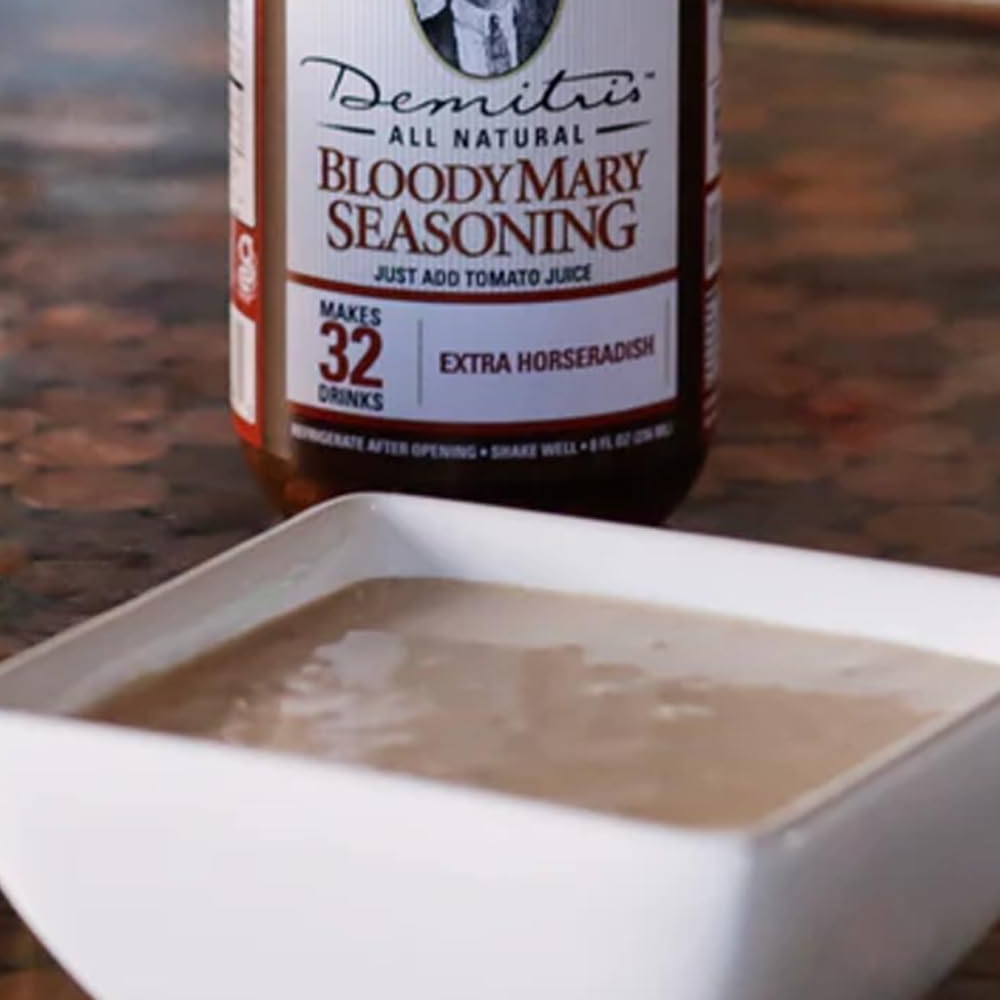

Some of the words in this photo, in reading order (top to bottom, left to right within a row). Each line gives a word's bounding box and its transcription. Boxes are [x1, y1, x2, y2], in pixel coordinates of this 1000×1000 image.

[388, 125, 437, 148] ALL
[453, 124, 585, 149] NATURAL
[317, 145, 513, 204] BLOODY
[515, 149, 649, 204] MARY
[326, 198, 638, 258] SEASONING
[373, 264, 418, 286] JUST
[421, 268, 461, 288] ADD
[465, 267, 541, 288] TOMATO
[544, 263, 593, 285] JUICE
[320, 300, 382, 326] MAKES
[318, 320, 384, 389] 32
[439, 352, 513, 374] EXTRA
[517, 334, 656, 373] HORSERADISH
[317, 383, 385, 412] DRINKS
[367, 437, 409, 456] AFTER
[411, 443, 476, 460] OPENING
[490, 443, 537, 459] SHAKE
[541, 441, 578, 456] WELL
